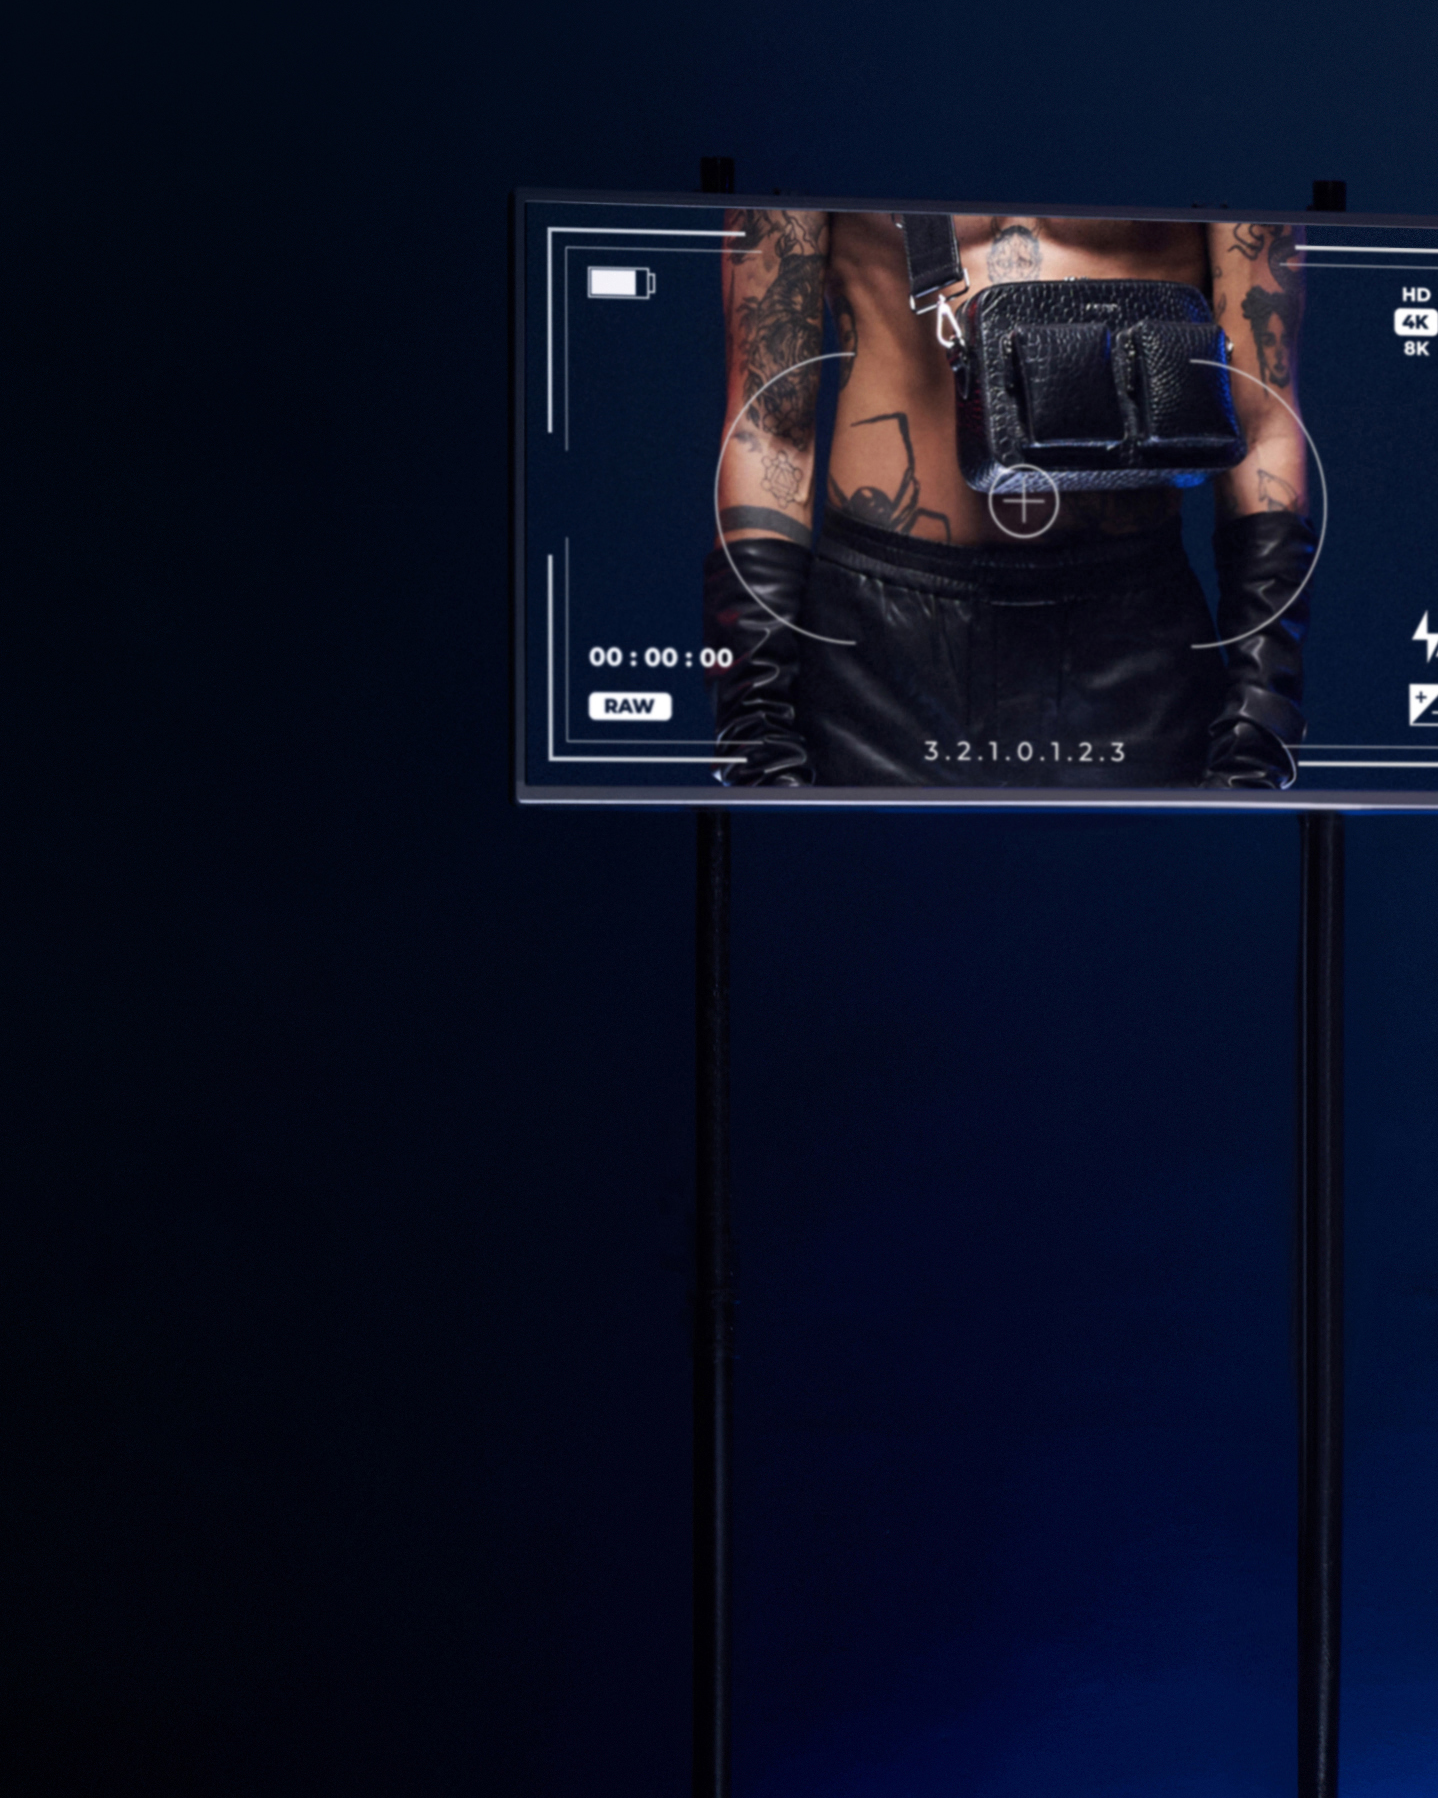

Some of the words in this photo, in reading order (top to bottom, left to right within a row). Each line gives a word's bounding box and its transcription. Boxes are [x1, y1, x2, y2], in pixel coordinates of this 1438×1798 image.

[1402, 286, 1431, 303] HD
[1402, 314, 1429, 330] 4K
[1403, 340, 1430, 356] 8K
[603, 698, 655, 714] RAW
[923, 740, 1126, 763] 3.2.1.0.1.2.3
